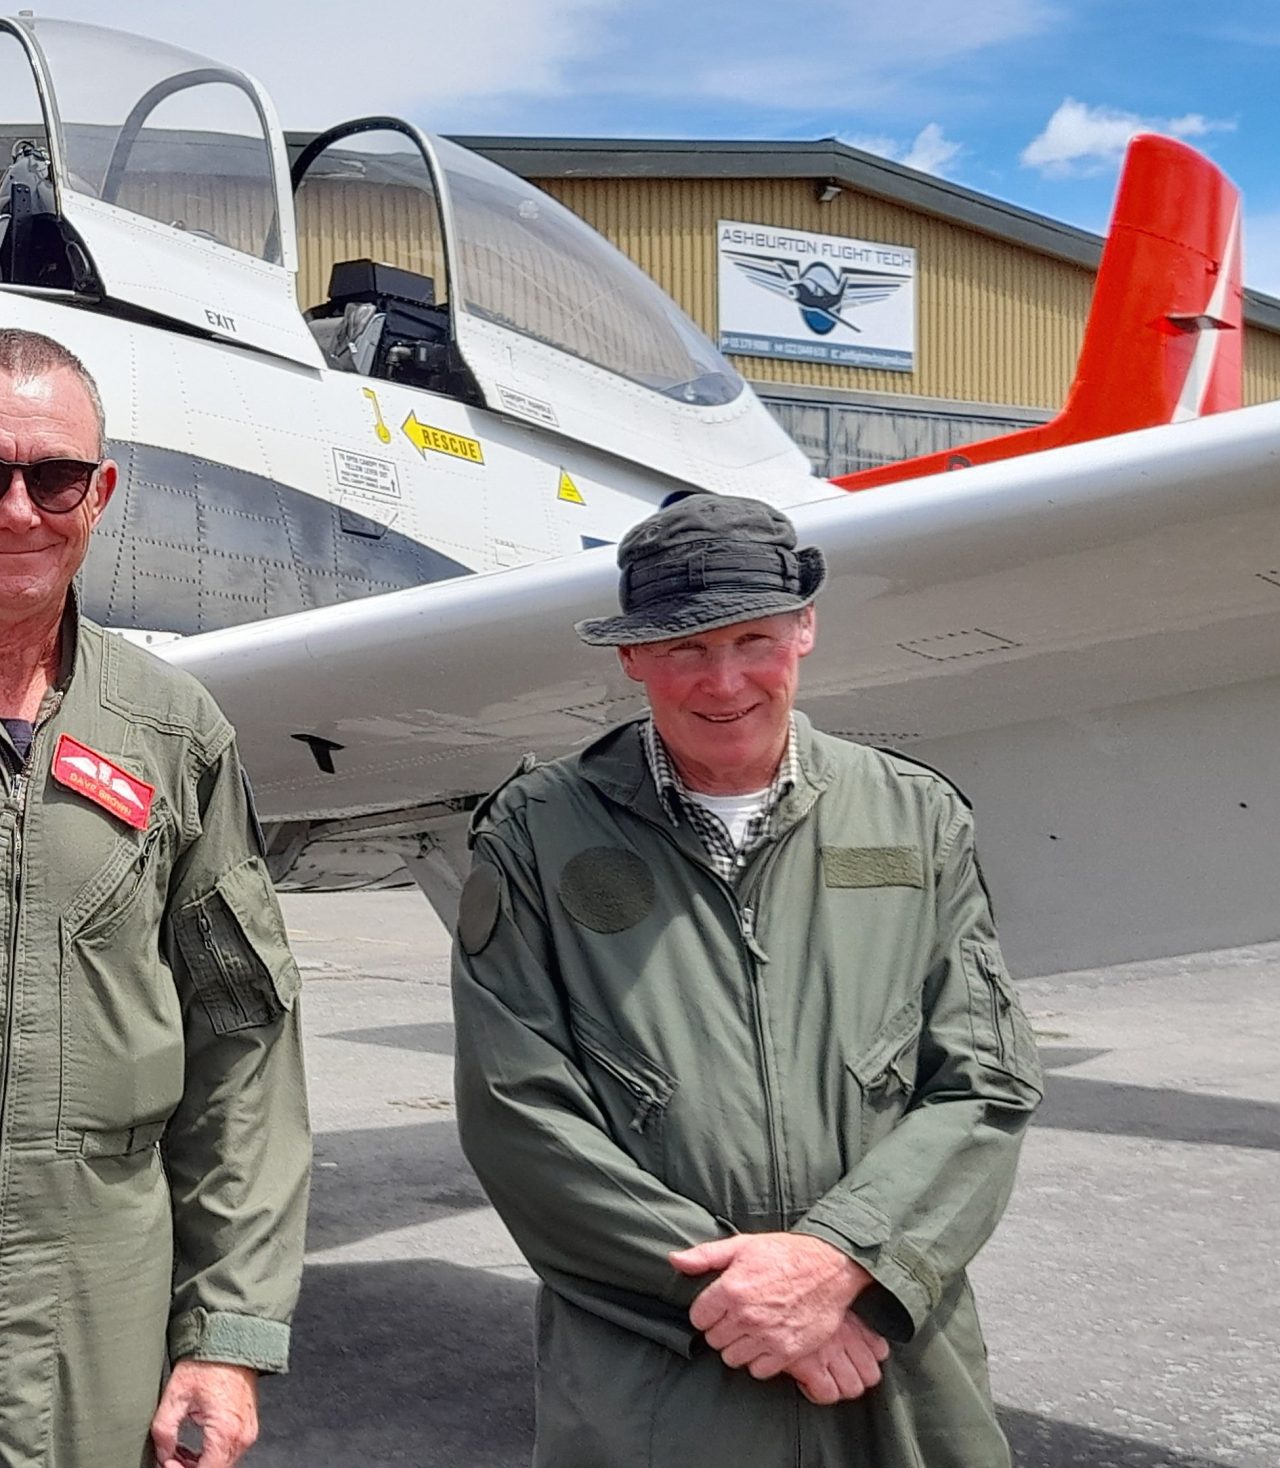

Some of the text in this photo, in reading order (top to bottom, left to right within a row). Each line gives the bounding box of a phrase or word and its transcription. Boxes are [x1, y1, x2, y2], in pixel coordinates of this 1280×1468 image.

[721, 228, 912, 267] ASHBURTON FLIGHT TECH
[204, 309, 237, 332] EXIT
[422, 429, 478, 458] RESCUE
[69, 772, 132, 816] DAVE BROWN
